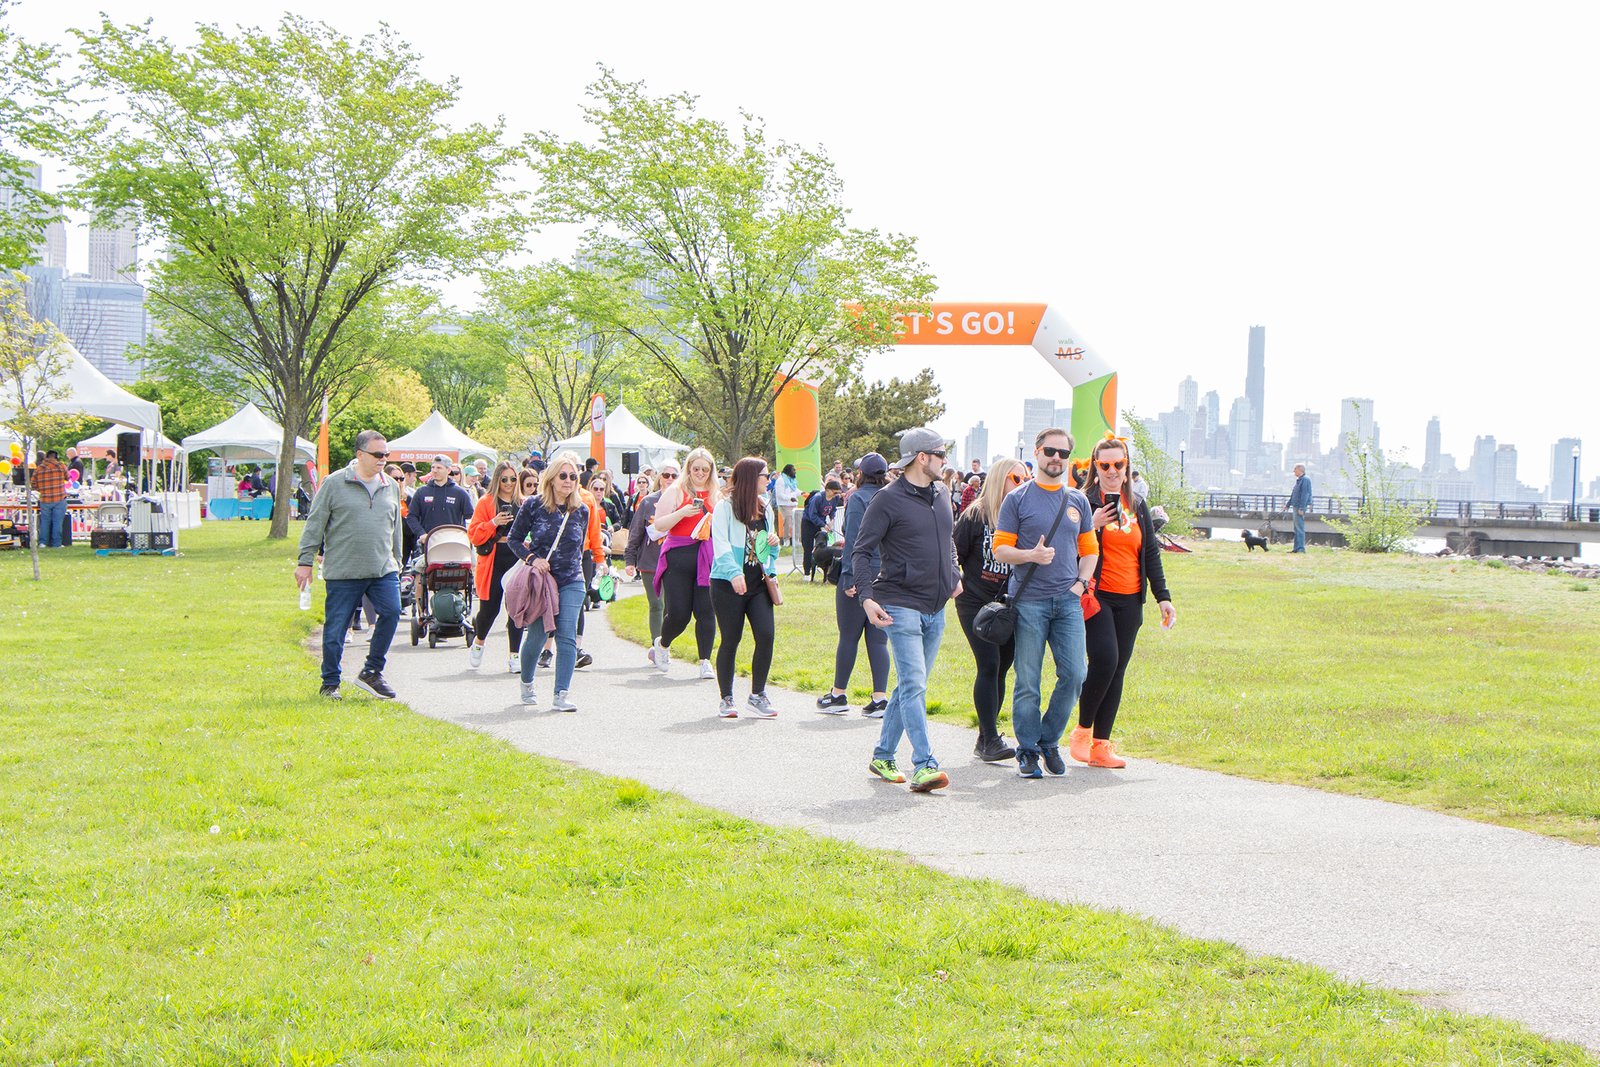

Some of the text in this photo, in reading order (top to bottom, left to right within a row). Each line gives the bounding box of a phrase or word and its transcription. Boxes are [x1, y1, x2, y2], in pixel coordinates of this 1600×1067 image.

[892, 311, 1014, 335] ET'S GO!
[983, 560, 1009, 575] FIGH
